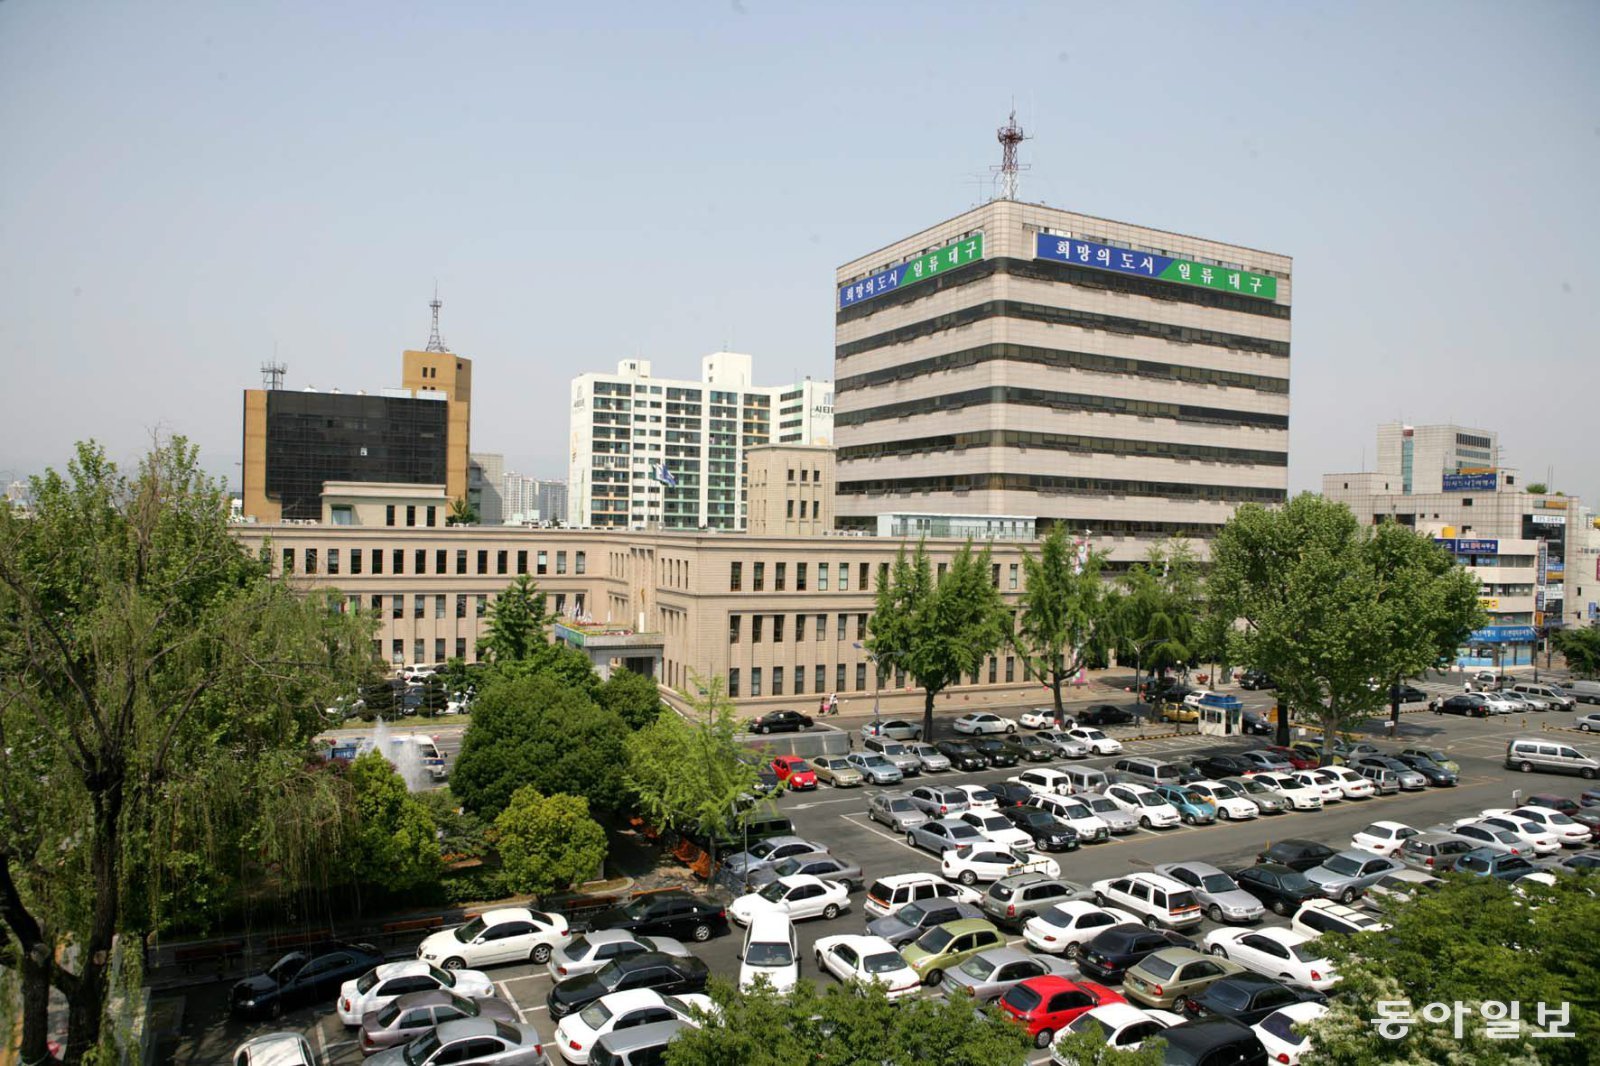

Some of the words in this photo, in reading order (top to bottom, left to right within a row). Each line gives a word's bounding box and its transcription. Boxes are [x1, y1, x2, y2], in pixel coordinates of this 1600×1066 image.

[845, 280, 874, 302] 희망의
[877, 271, 898, 290] 도시
[913, 256, 939, 277] 일류
[948, 241, 977, 264] 대구
[1055, 240, 1110, 267] 희망의
[1120, 252, 1154, 275] 도시
[1178, 262, 1214, 285] 일류
[1228, 272, 1263, 294] 대구
